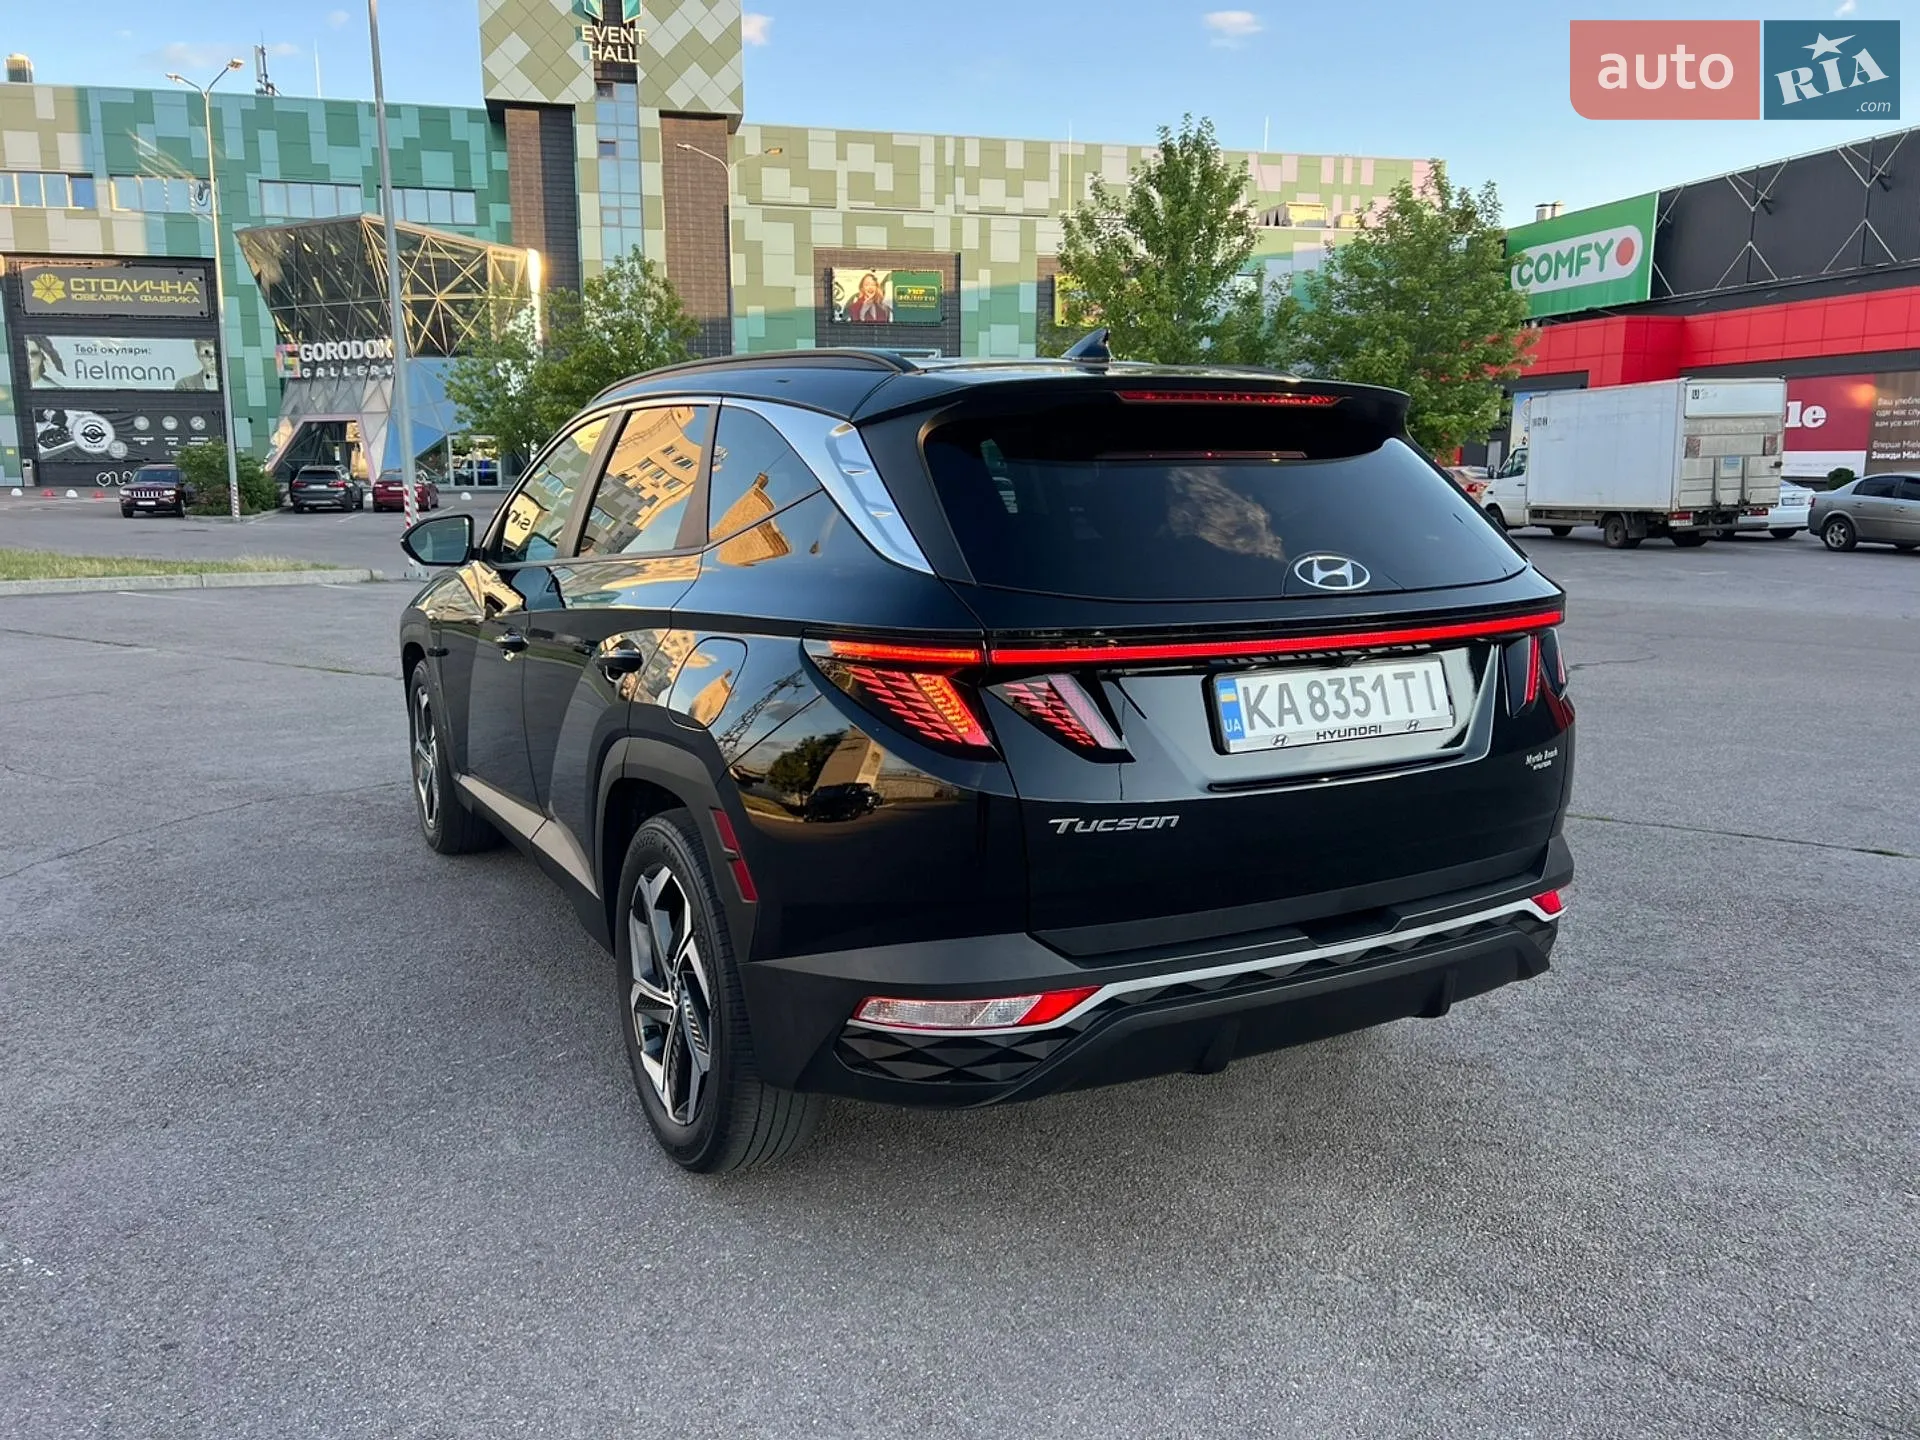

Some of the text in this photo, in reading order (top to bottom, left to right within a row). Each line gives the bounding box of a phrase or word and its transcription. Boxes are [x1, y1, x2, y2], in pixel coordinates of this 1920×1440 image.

[581, 24, 648, 45] EVENT
[588, 44, 641, 63] HALL
[1516, 237, 1614, 287] COMFY
[70, 277, 200, 295] СТОЛИЧНА
[139, 294, 200, 304] ФАБРИКА
[300, 337, 394, 362] GORODOK
[302, 364, 393, 379] GALLERY
[1224, 718, 1242, 734] UA
[1315, 724, 1383, 741] HYUNDAI
